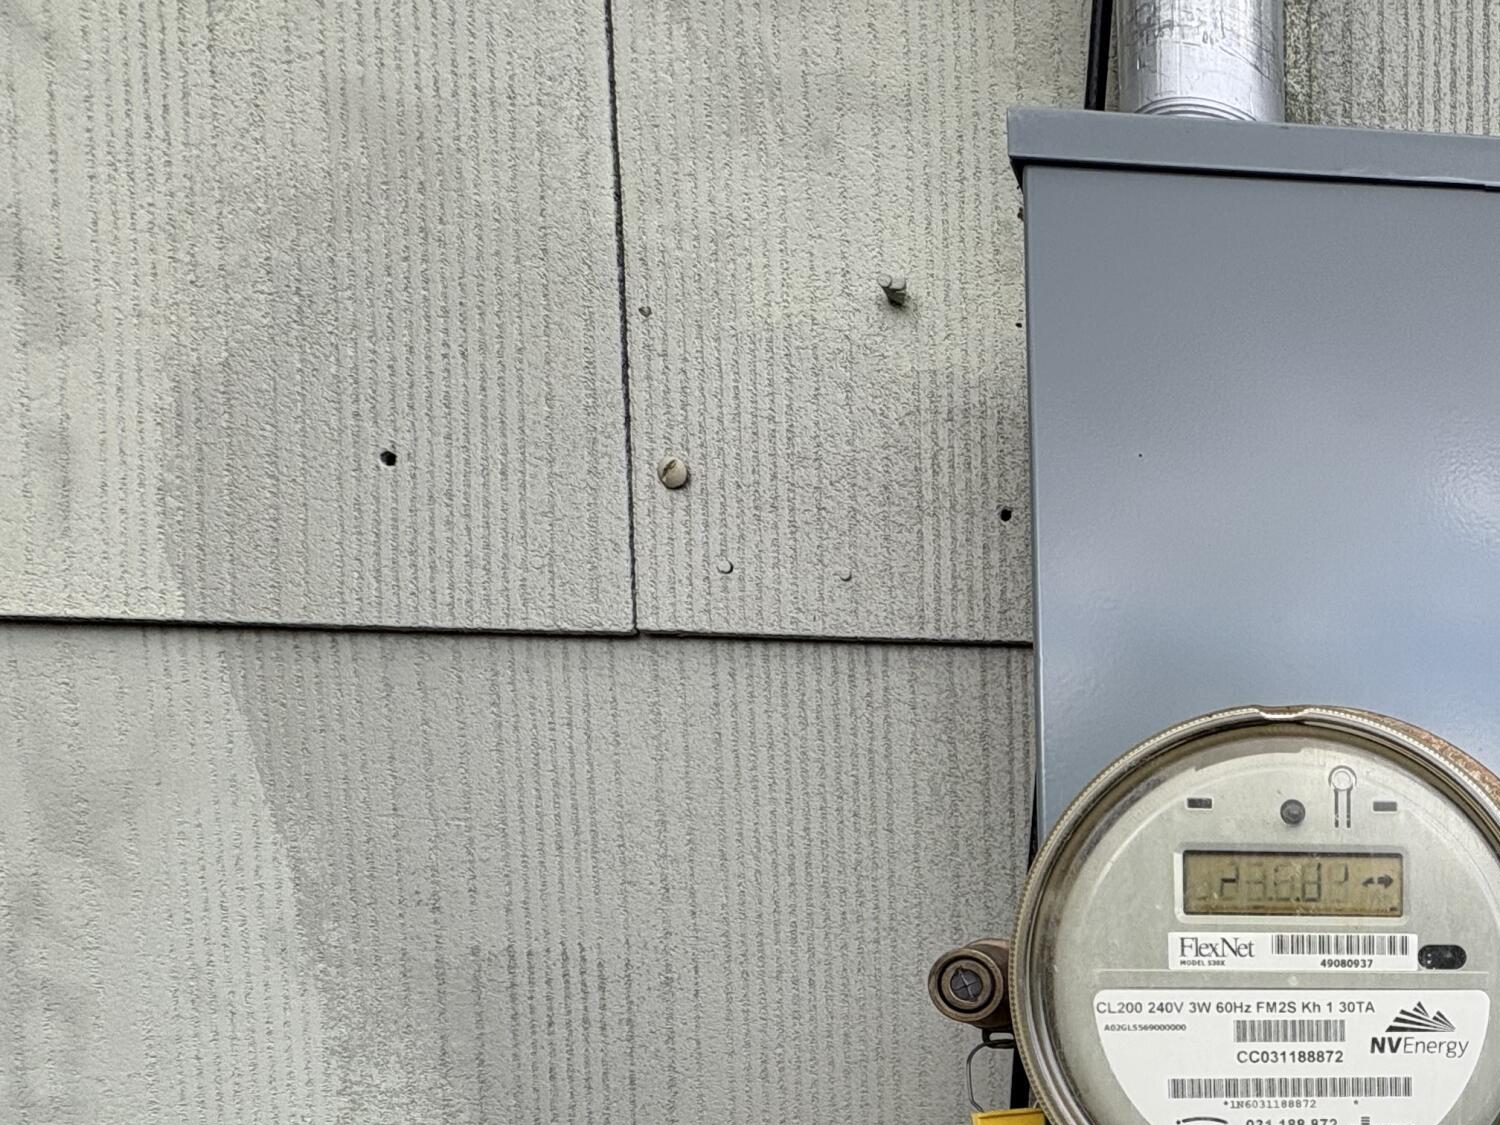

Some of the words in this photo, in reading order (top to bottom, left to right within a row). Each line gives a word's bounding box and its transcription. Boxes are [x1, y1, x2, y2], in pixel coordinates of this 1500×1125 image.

[1179, 937, 1255, 958] FlexNet
[1320, 959, 1373, 969] 49080937
[1096, 1002, 1143, 1014] CL200
[1147, 1002, 1184, 1014] 240V
[1188, 1002, 1212, 1014] 3W
[1216, 1002, 1252, 1014] 60Hz
[1256, 1002, 1297, 1013] FM2S
[1302, 1001, 1321, 1013] Kh
[1326, 1002, 1333, 1013] 1
[1339, 1001, 1376, 1013] 30TA
[1236, 1050, 1344, 1063] CC031188872
